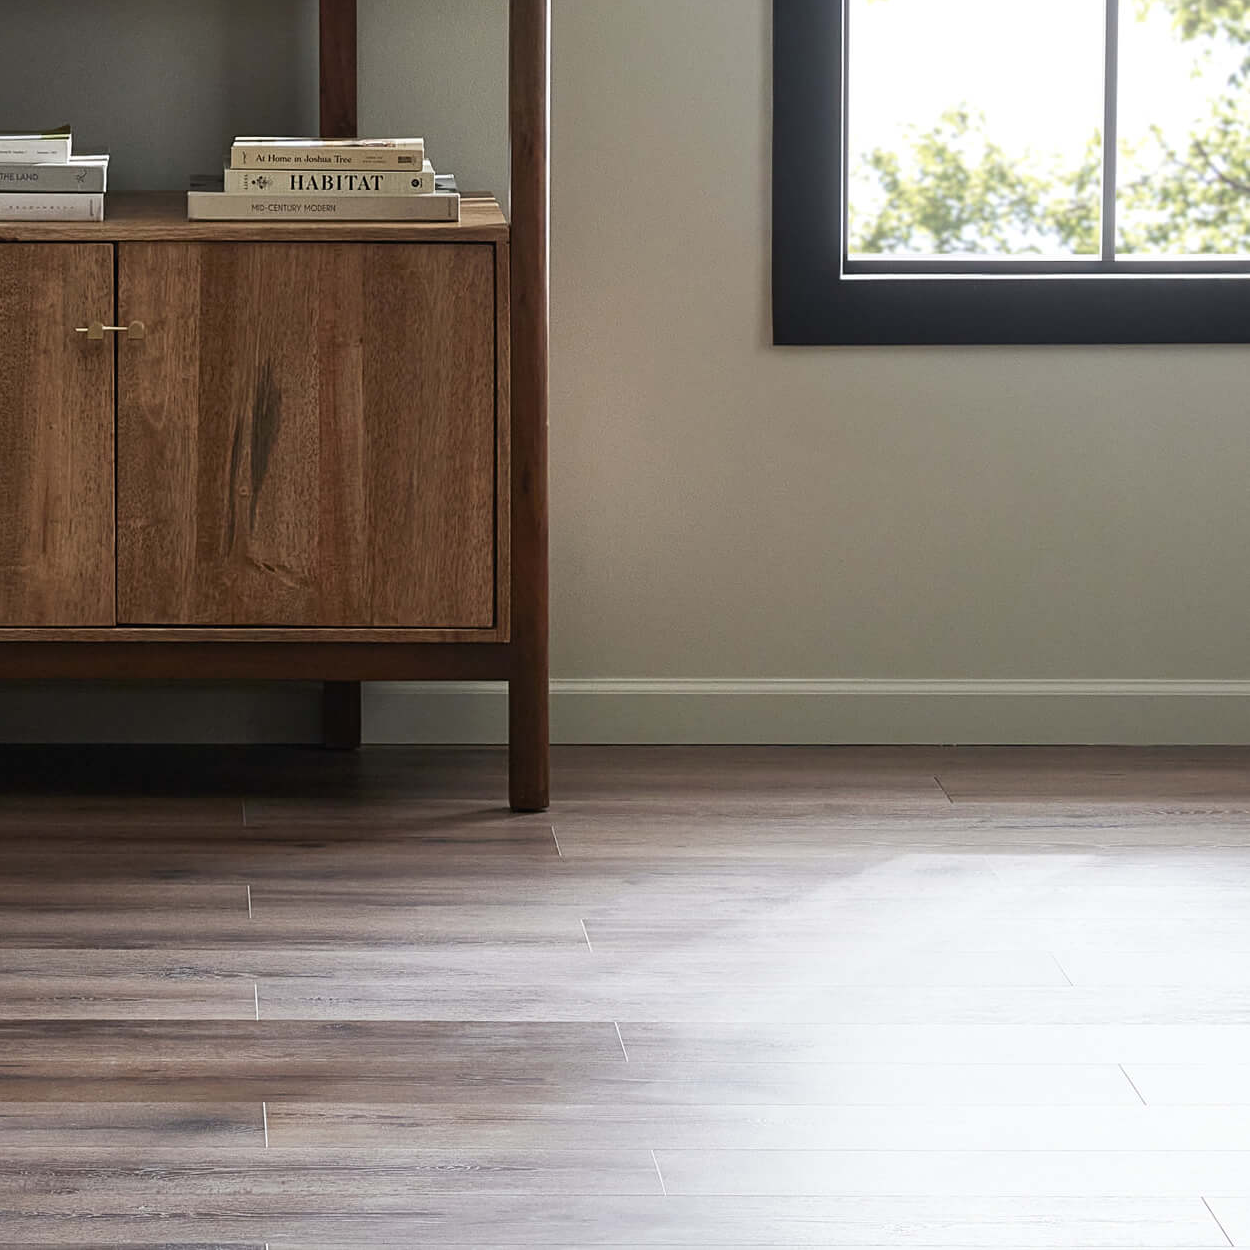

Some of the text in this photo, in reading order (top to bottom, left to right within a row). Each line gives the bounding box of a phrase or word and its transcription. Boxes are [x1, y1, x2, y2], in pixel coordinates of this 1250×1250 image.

[267, 155, 291, 163] Home
[294, 155, 302, 163] in
[304, 154, 332, 163] Joshua
[334, 155, 351, 163] Tree
[16, 173, 38, 181] LAND
[291, 175, 383, 190] HABITAT
[252, 204, 335, 213] MID-CENTURY MODERN
